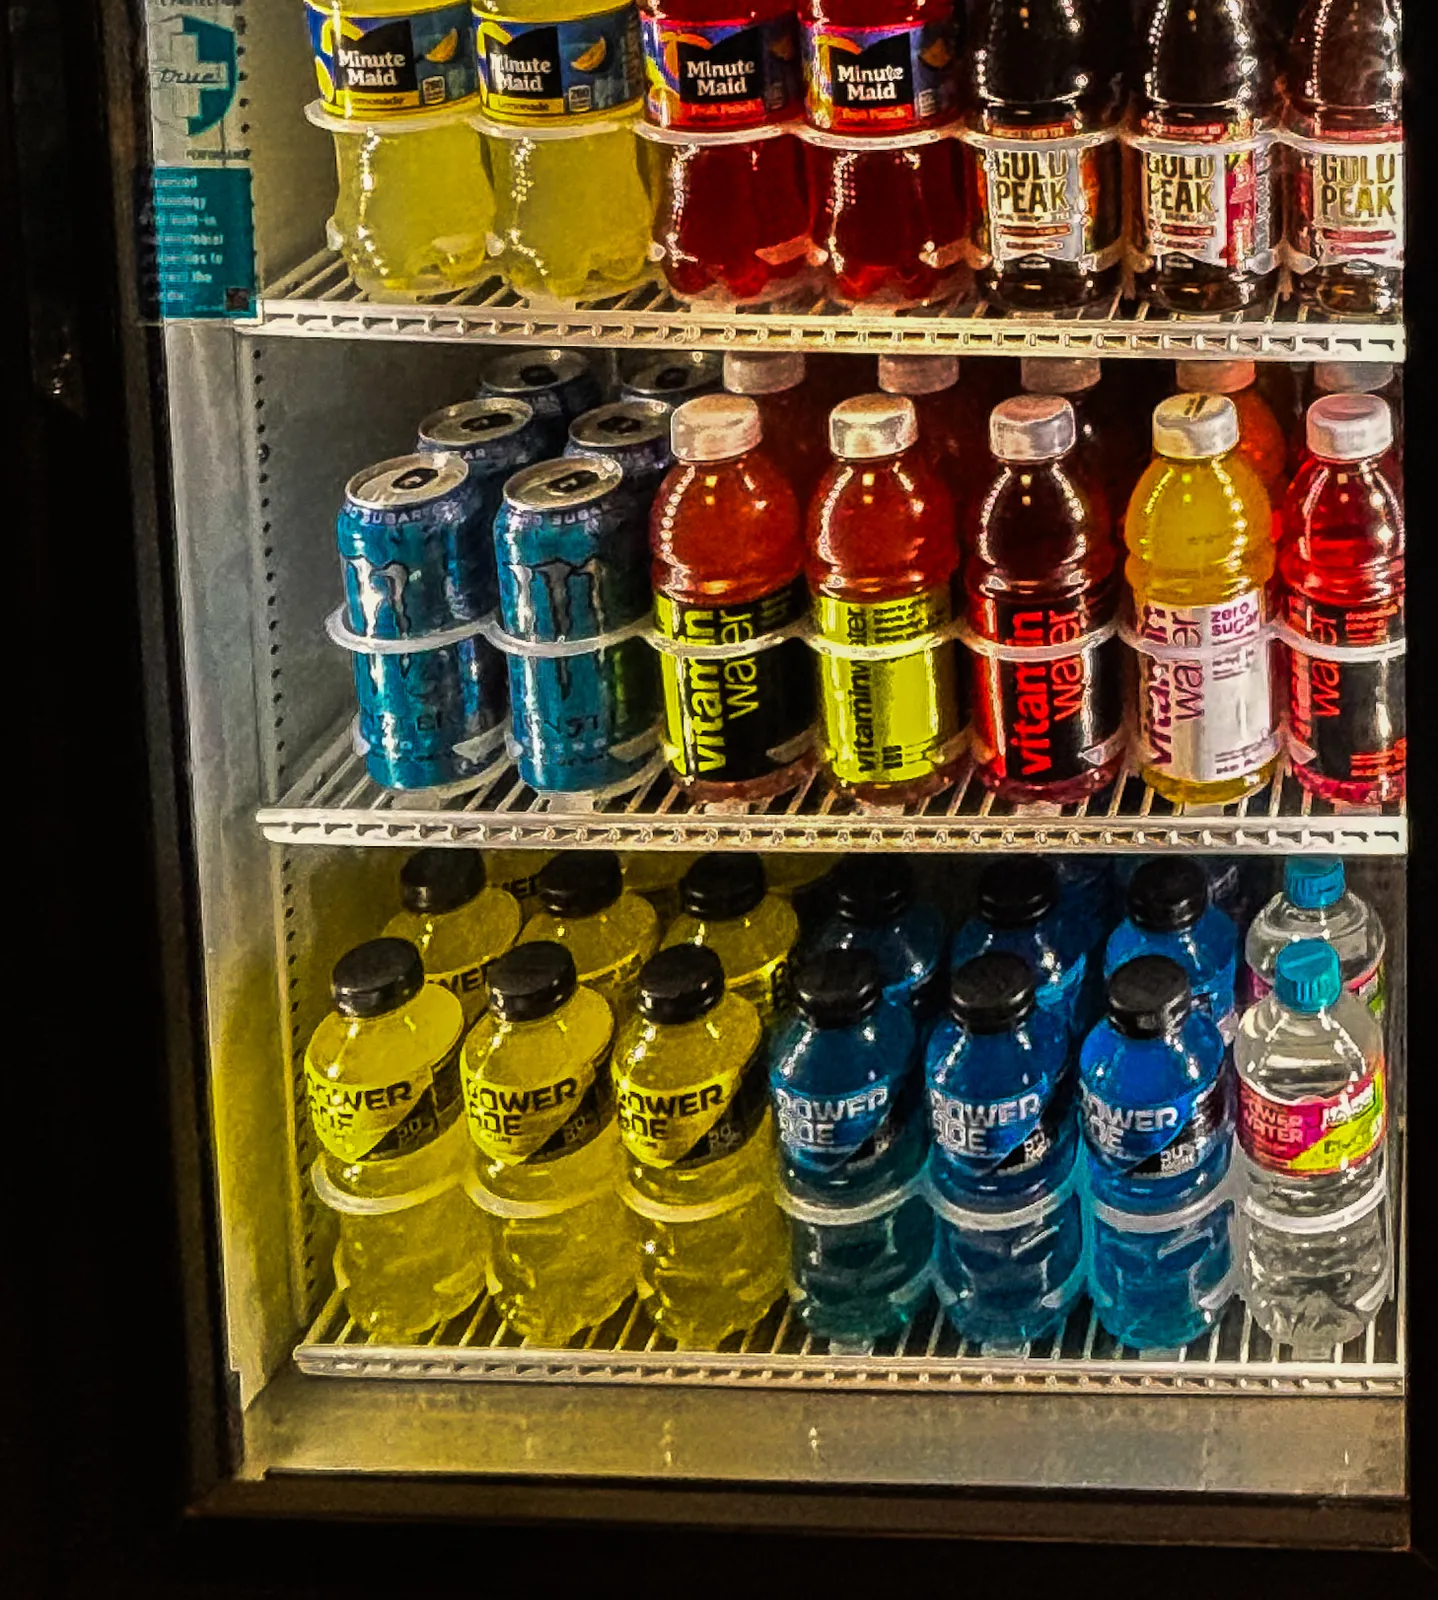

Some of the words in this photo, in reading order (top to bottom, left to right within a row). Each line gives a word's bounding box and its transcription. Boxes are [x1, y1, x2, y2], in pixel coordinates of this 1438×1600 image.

[338, 50, 406, 69] Minute
[346, 68, 398, 87] Maid
[687, 60, 756, 80] Minute
[837, 64, 904, 84] Minute
[696, 77, 747, 97] Maid
[847, 82, 897, 101] Maid
[996, 181, 1070, 213] PEAK
[1321, 184, 1397, 218] PEAK
[1210, 601, 1250, 622] zero
[1211, 612, 1259, 638] sugar
